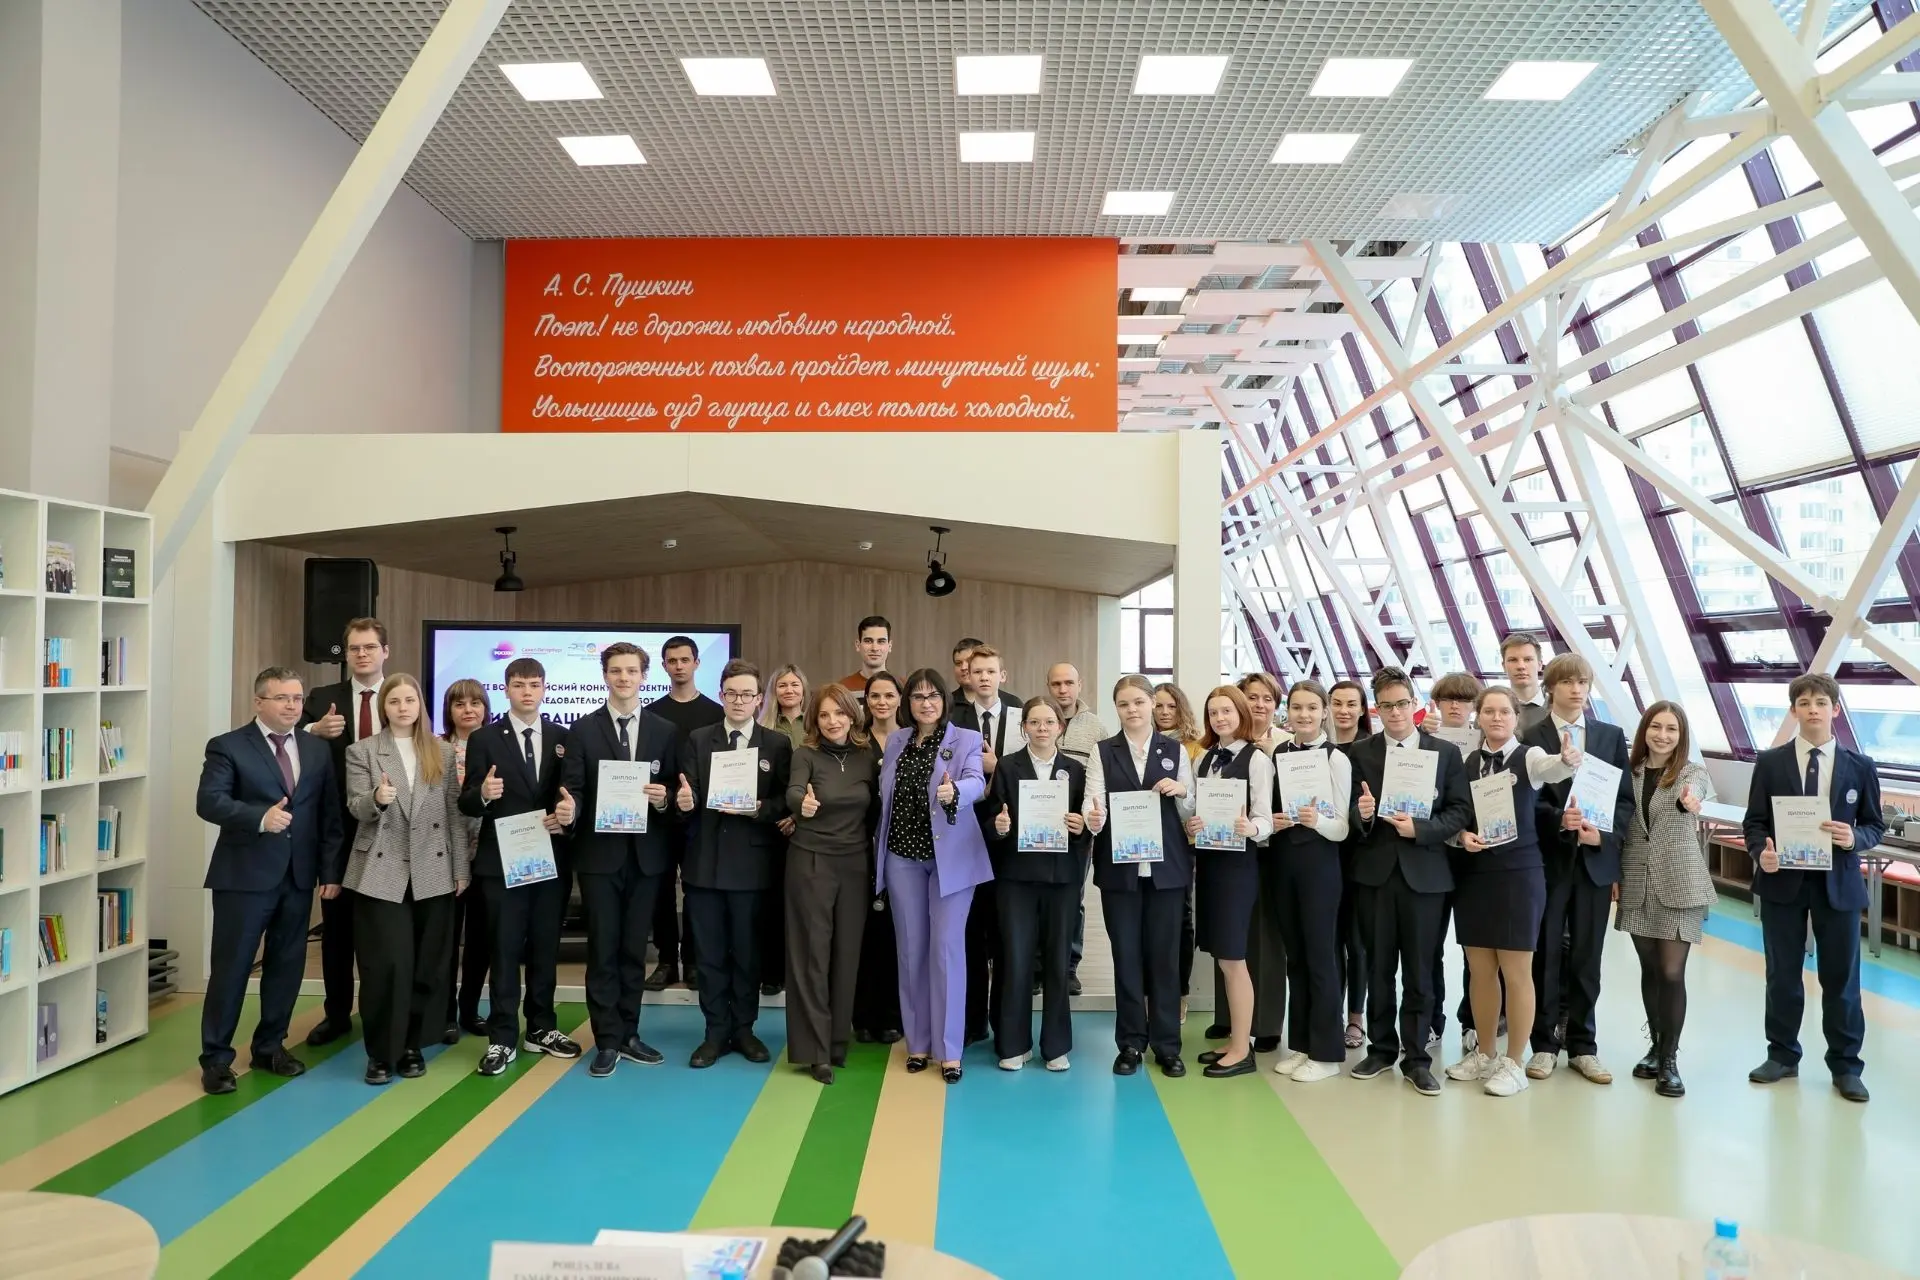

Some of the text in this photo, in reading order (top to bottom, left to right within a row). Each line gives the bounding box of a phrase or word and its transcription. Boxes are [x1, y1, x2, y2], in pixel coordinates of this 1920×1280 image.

[544, 272, 694, 307] А. С. Пушкин
[534, 311, 956, 343] Поэт! не дорожи любовию народной.
[534, 354, 705, 384] Восторженных
[709, 353, 786, 377] похвал
[790, 353, 891, 382] пройдет
[895, 354, 1028, 388] минутный
[532, 394, 1076, 430] Услышишь суд глупца и смех толпы холодной.
